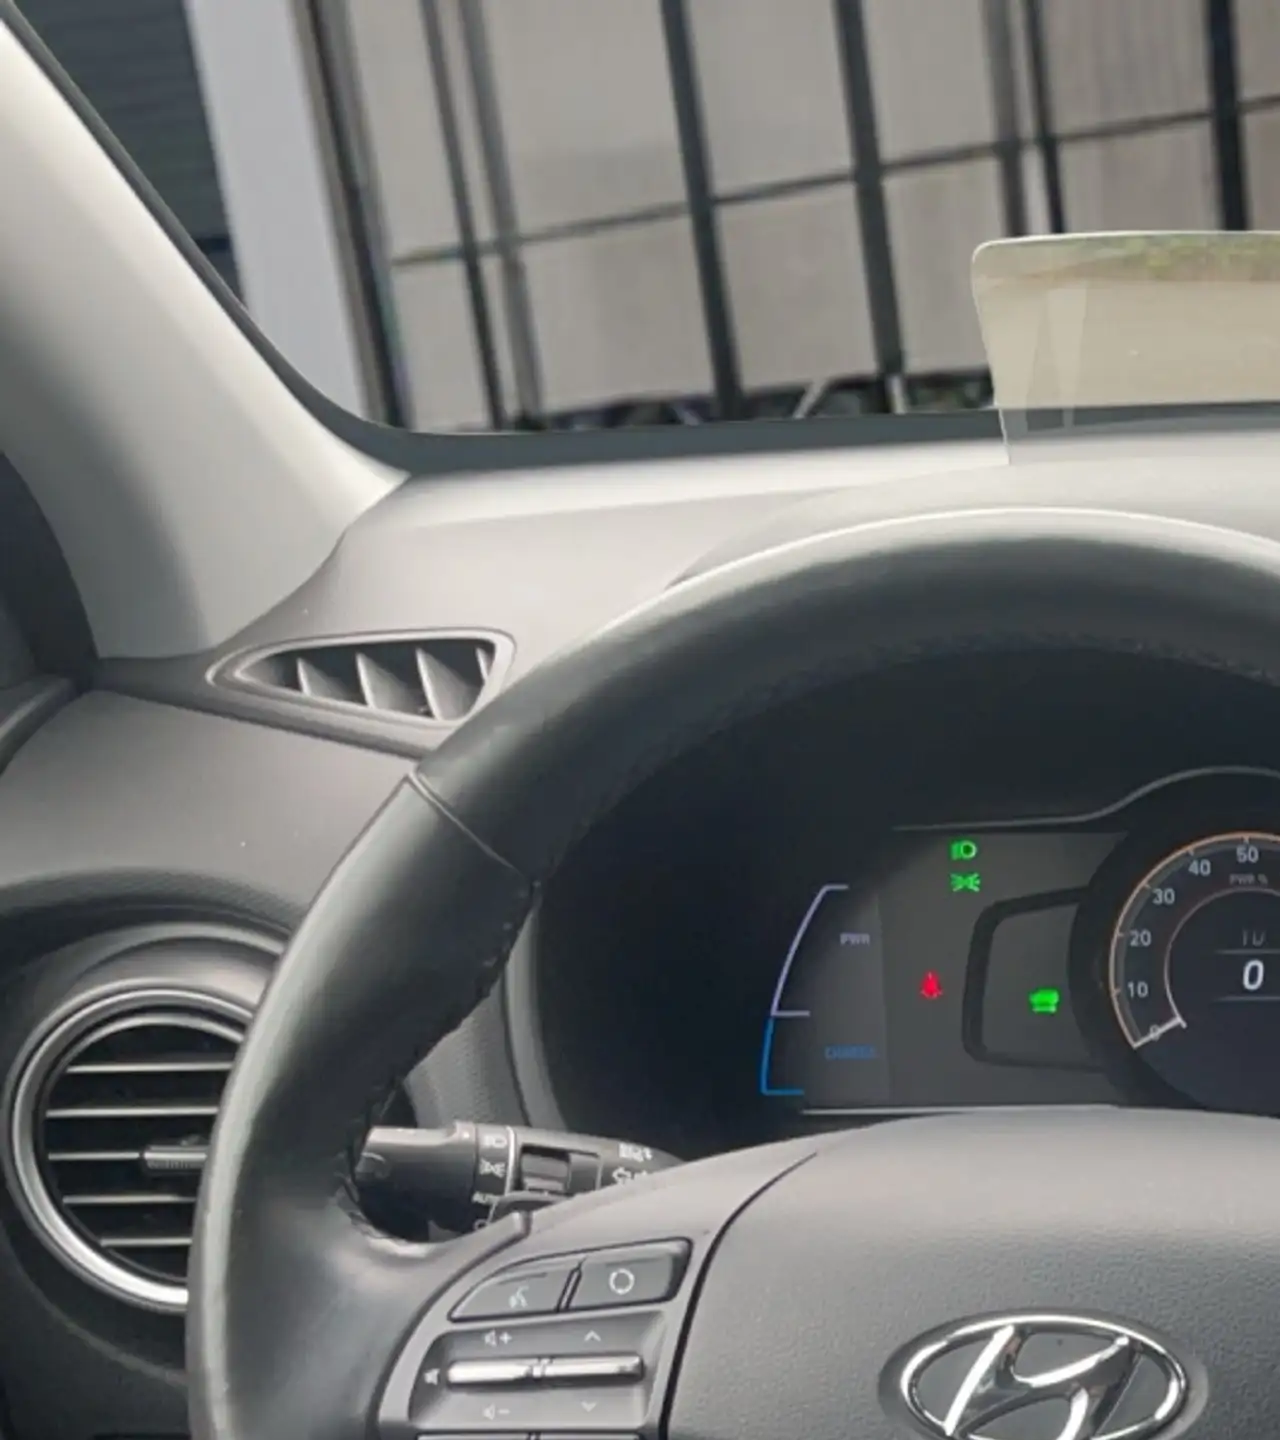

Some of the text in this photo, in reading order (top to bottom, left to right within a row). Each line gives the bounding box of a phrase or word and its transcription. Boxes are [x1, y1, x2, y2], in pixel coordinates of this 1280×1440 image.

[1236, 846, 1258, 863] 50
[1188, 859, 1212, 876] 40
[1153, 888, 1175, 906] 30
[1129, 930, 1151, 947] 20
[1242, 959, 1265, 991] 0
[1127, 981, 1147, 998] 10
